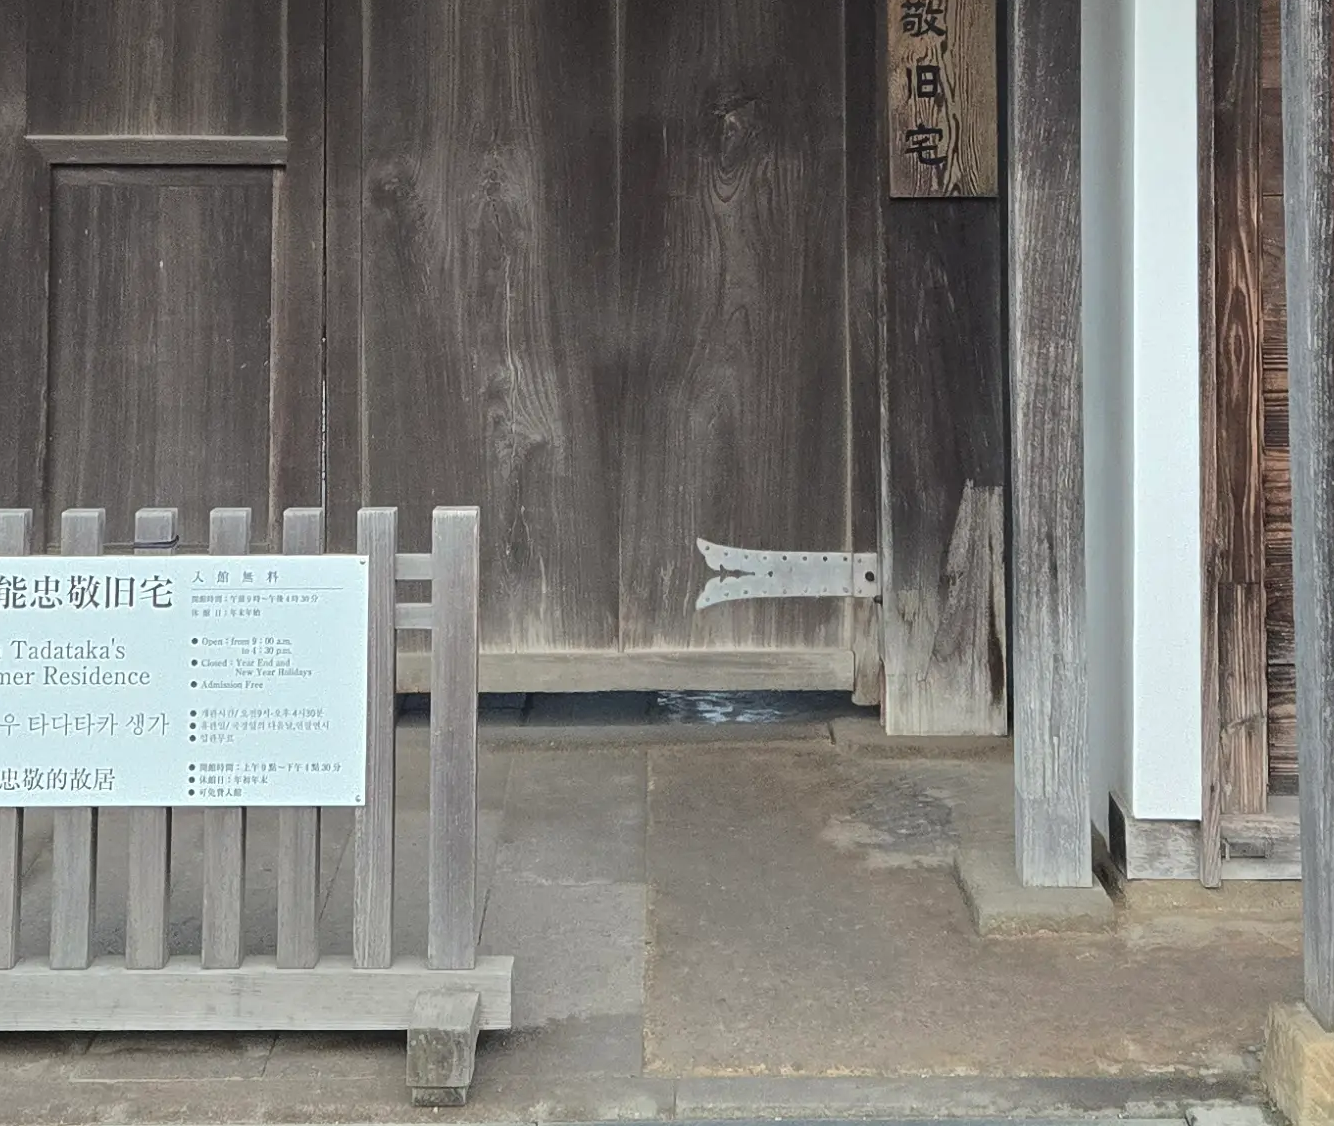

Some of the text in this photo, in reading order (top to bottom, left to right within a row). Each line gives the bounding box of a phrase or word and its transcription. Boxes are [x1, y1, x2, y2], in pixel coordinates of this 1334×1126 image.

[191, 570, 280, 584] 入館無料
[10, 637, 127, 660] Tadataka's
[236, 658, 255, 668] Year
[257, 658, 273, 668] End
[276, 658, 291, 668] and
[43, 666, 152, 686] Residence
[235, 667, 313, 678] New Year Holidays
[201, 680, 264, 690] Admission Free
[28, 712, 119, 737] 타다타카
[125, 712, 170, 737] 생가
